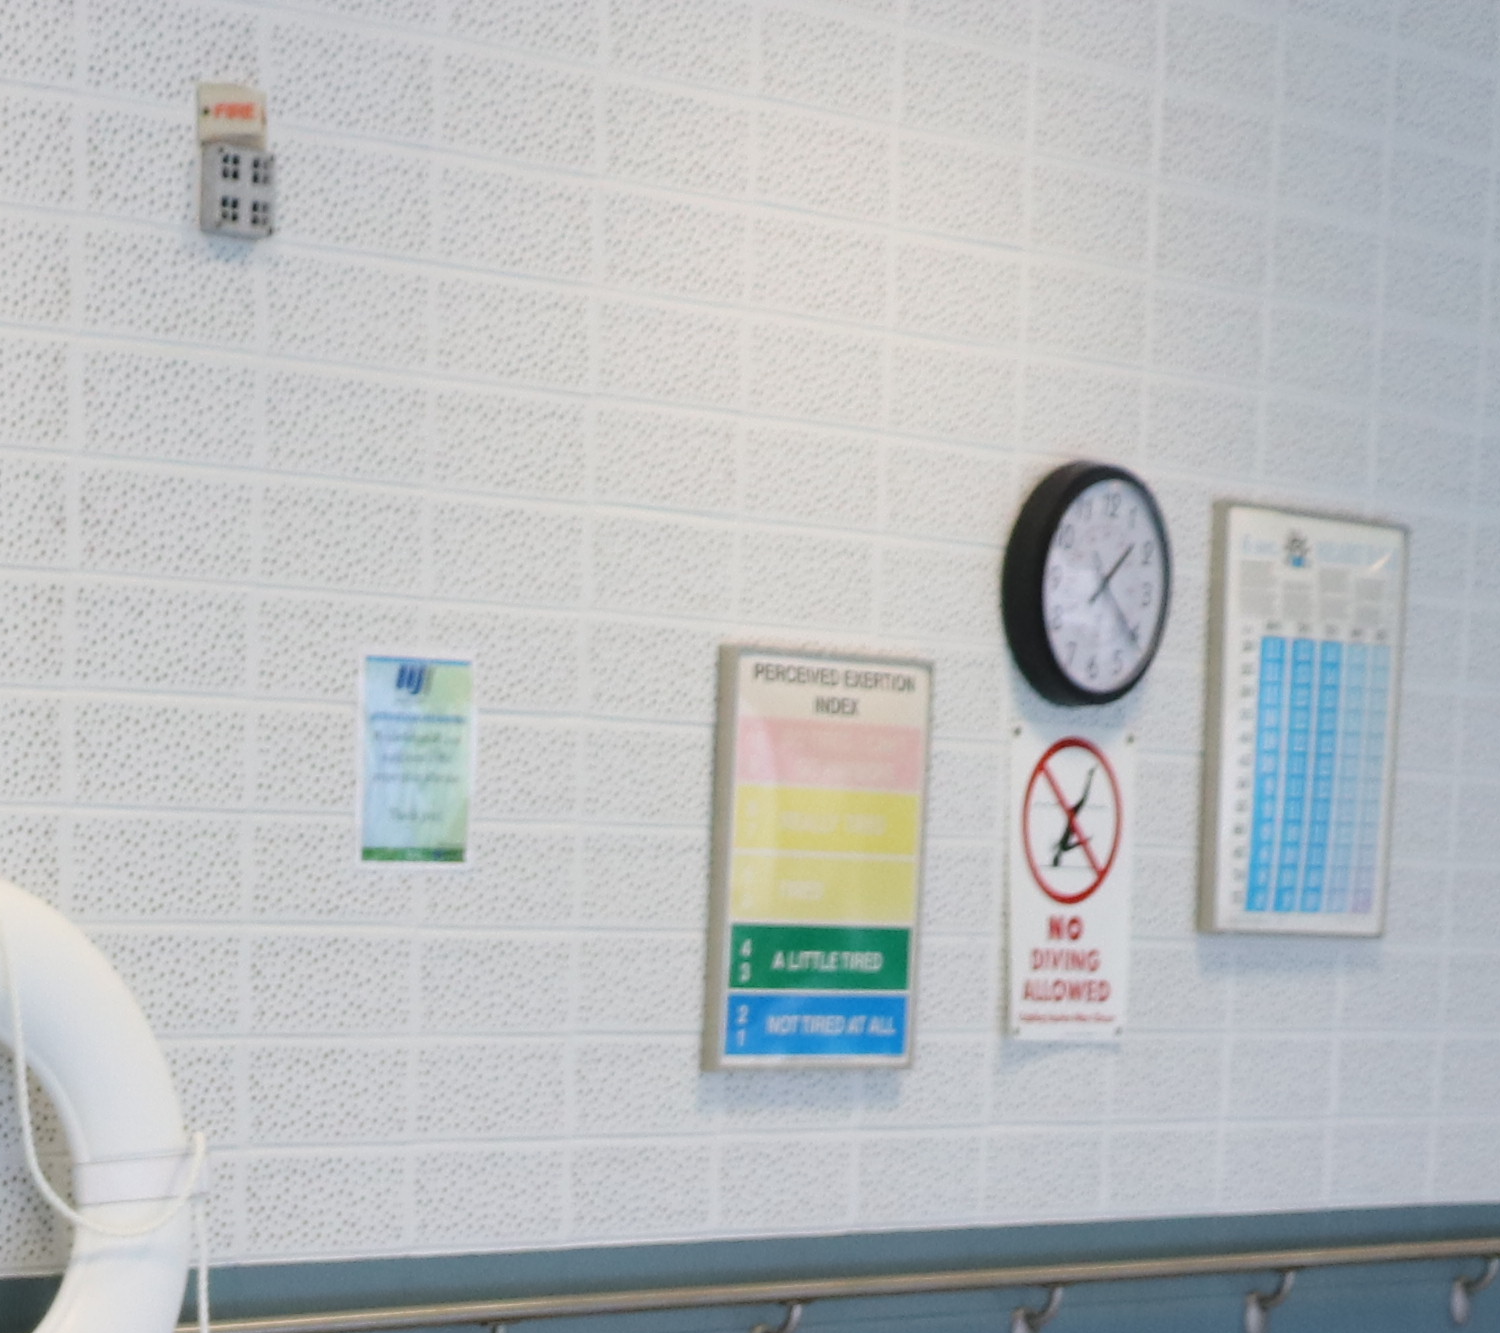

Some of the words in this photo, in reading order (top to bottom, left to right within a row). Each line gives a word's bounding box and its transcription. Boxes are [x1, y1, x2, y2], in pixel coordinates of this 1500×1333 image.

[754, 663, 839, 686] PERCEIVED
[845, 670, 916, 692] EXERTION
[814, 695, 860, 715] INDEX
[1048, 915, 1084, 940] NO
[788, 951, 838, 972] LITTLE
[843, 951, 884, 972] TIRED
[1031, 949, 1101, 972] DIVING
[1024, 979, 1112, 1002] ALLOWED
[766, 1015, 800, 1035] NOT
[803, 1015, 845, 1035] TIRED
[847, 1015, 867, 1035] AT
[869, 1015, 896, 1035] ALL
